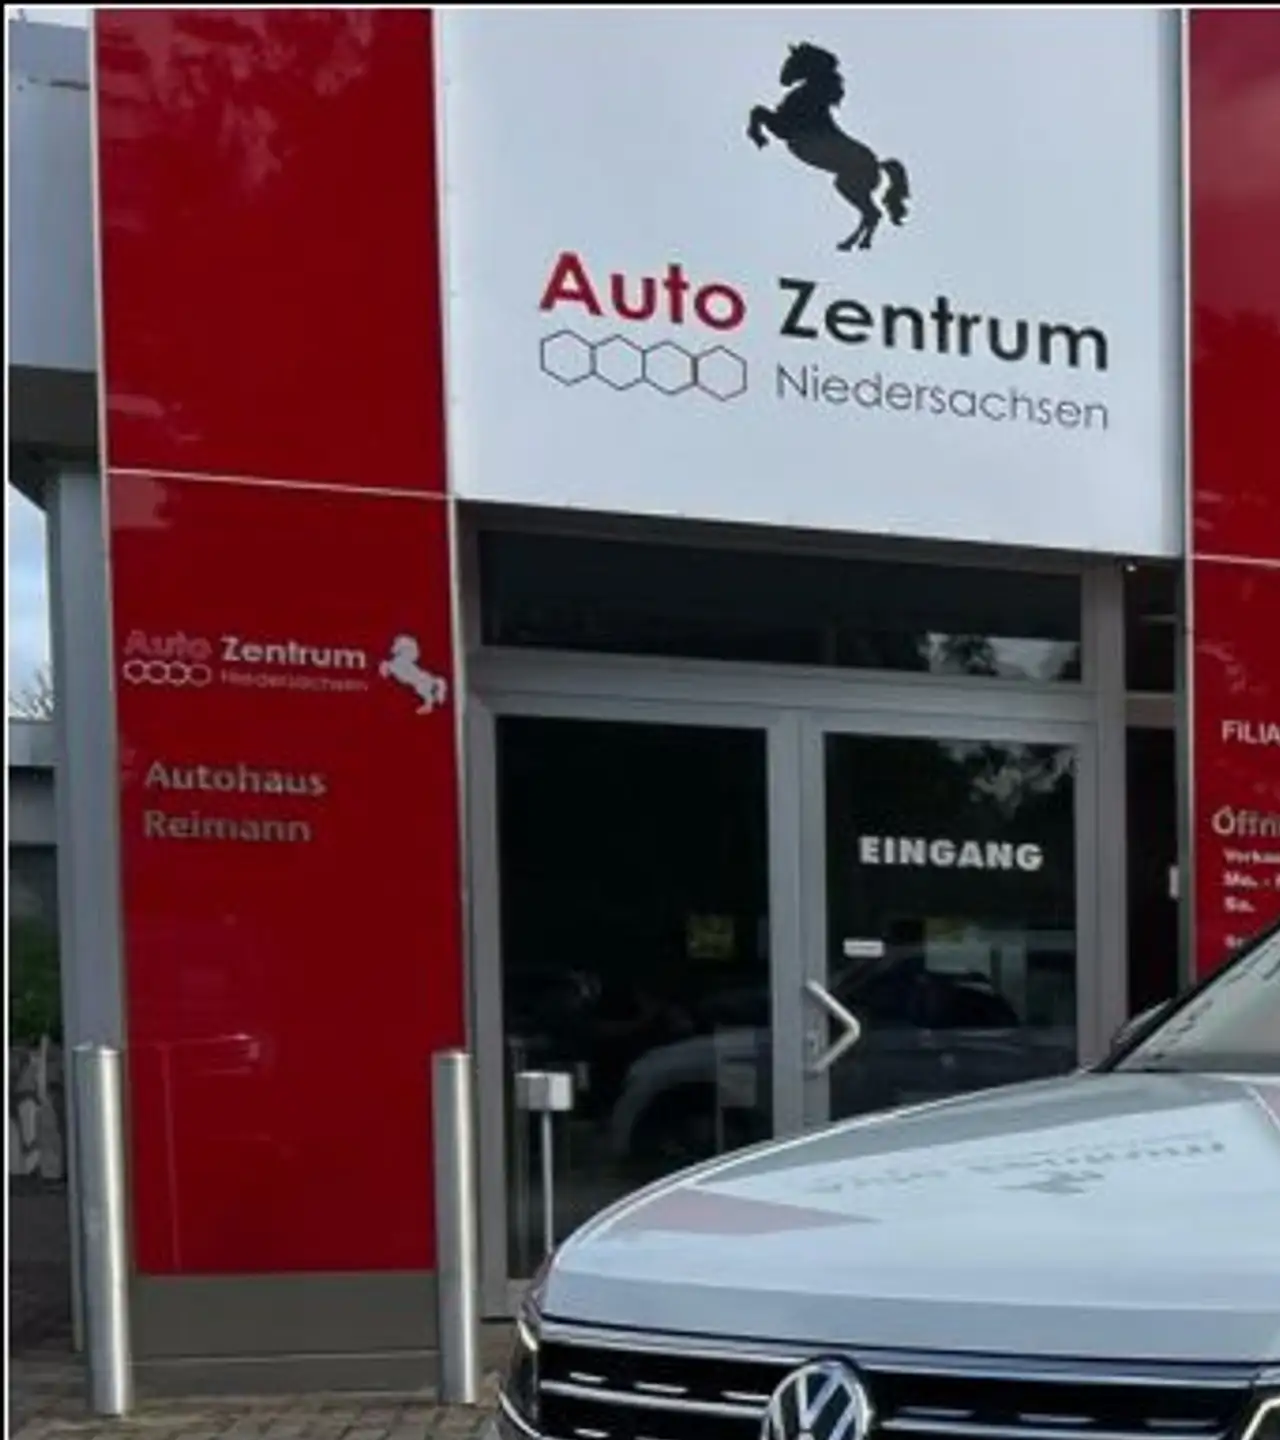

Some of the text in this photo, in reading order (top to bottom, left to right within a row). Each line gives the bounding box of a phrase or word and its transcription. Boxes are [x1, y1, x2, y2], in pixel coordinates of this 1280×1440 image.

[539, 251, 1109, 371] Auto Zentrum
[776, 364, 1109, 431] Niedersachsen
[124, 630, 368, 670] Auto Zentrum
[144, 760, 328, 797] Autohaus
[143, 810, 312, 842] Reimann
[859, 836, 1043, 871] EINGANG
